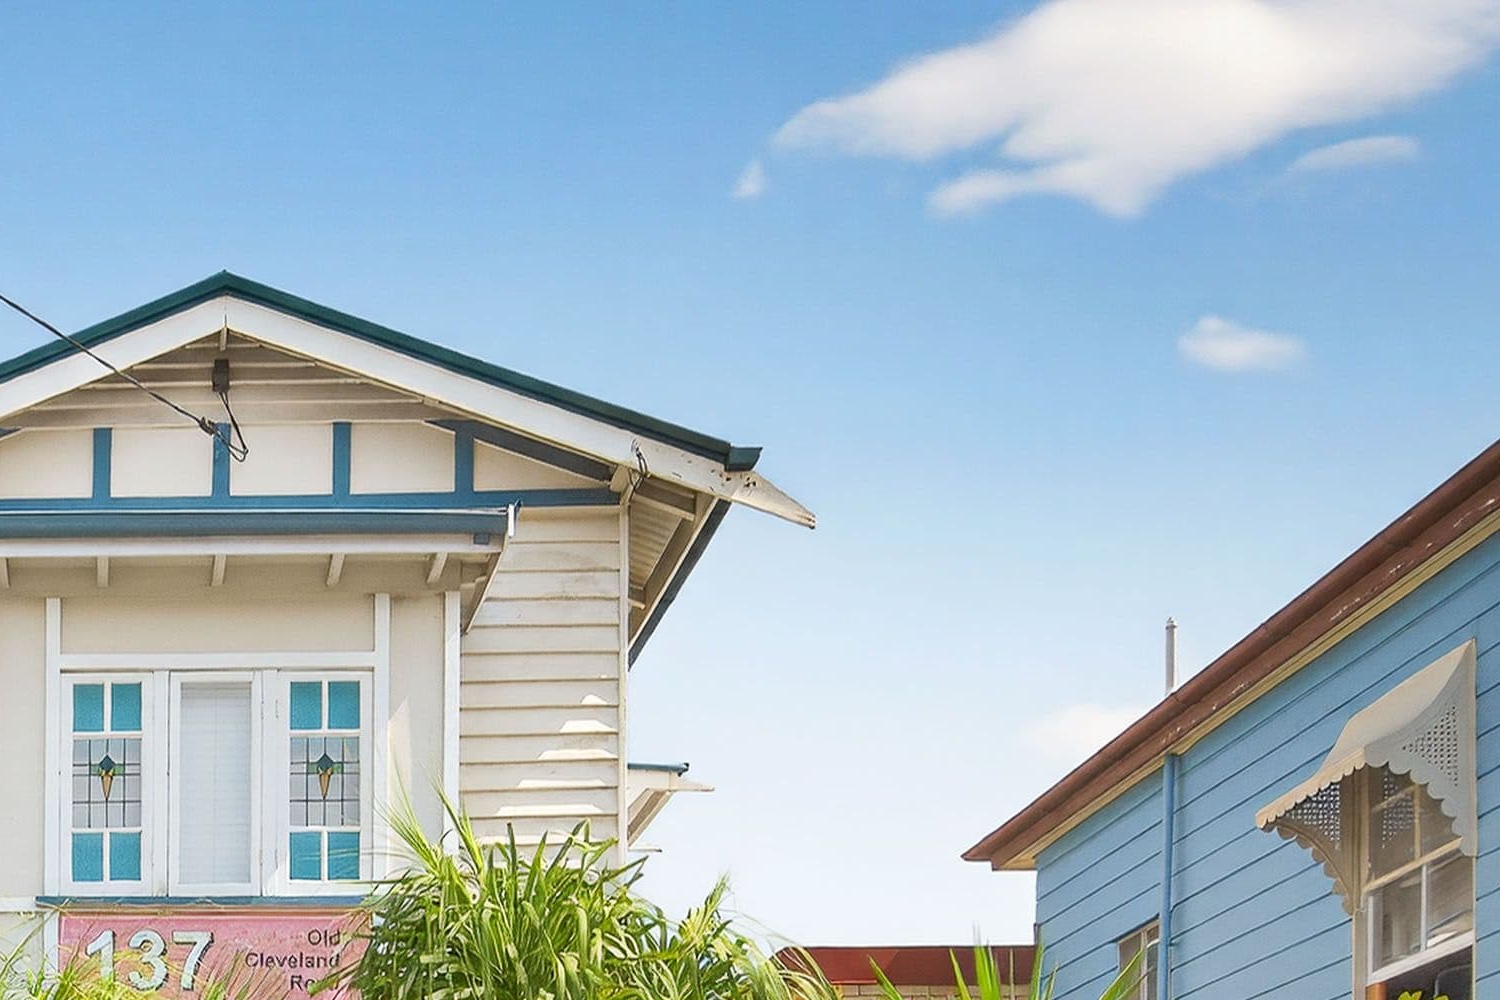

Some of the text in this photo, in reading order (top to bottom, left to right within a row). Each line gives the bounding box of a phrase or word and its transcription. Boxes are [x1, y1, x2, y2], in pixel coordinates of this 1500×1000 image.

[307, 928, 341, 947] Old
[85, 928, 215, 993] 137
[245, 951, 340, 969] Cleveland
